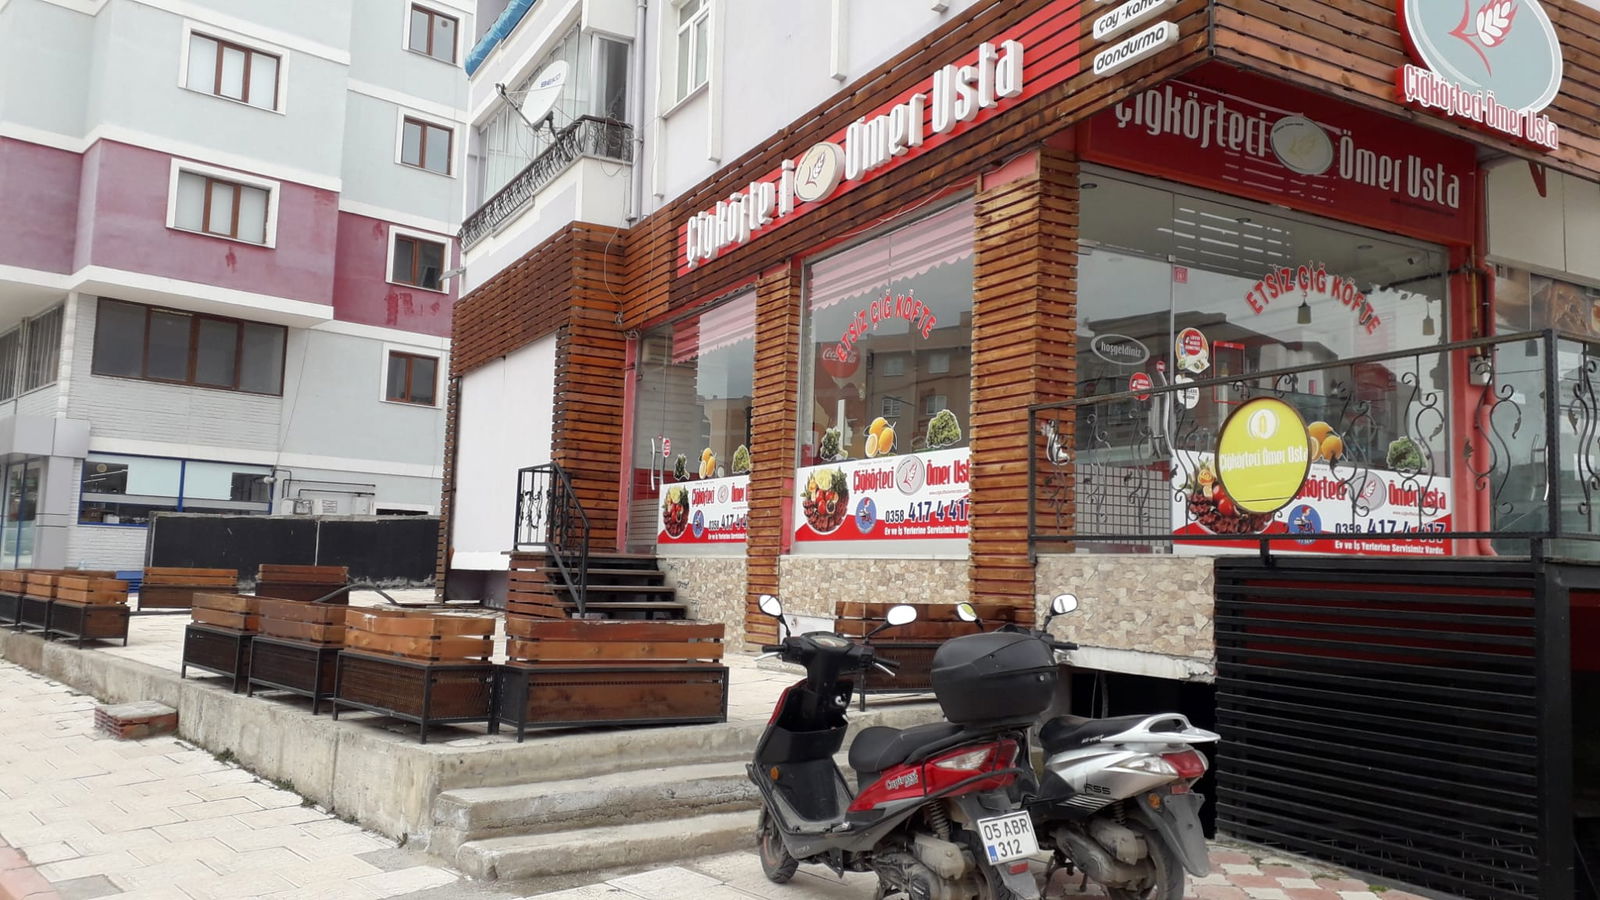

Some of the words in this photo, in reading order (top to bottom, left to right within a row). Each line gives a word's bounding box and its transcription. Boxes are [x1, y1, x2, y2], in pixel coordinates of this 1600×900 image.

[1096, 27, 1164, 70] dondurma
[845, 93, 927, 181] Ömer
[932, 39, 1024, 133] Usta
[1404, 64, 1483, 123] Çiğköfteci
[1486, 90, 1524, 138] Ömer
[1526, 108, 1559, 150] Usta
[1339, 129, 1402, 193] Ömer
[1407, 154, 1460, 209] Usta
[1245, 263, 1296, 316] ETSİZ
[1296, 259, 1327, 299] ÇİĞ
[1330, 274, 1382, 336] KÖFTE
[835, 309, 870, 362] ETSİZ
[869, 288, 894, 331] ÇİĞ
[895, 288, 938, 340] KÖFTE
[853, 466, 894, 494] Çiğköfteci
[926, 459, 952, 486] Ömer
[953, 458, 971, 484] Ust
[1388, 479, 1418, 507] Ömer
[885, 509, 905, 523] 0358
[908, 501, 933, 522] 417
[936, 500, 945, 521] 4
[1367, 518, 1397, 536] 417
[1335, 540, 1343, 549] Ev
[1344, 542, 1353, 550] ve
[1361, 542, 1391, 552] Yerlerine
[984, 823, 1001, 841] 05
[1004, 818, 1030, 838] ABR
[998, 838, 1023, 858] 312
